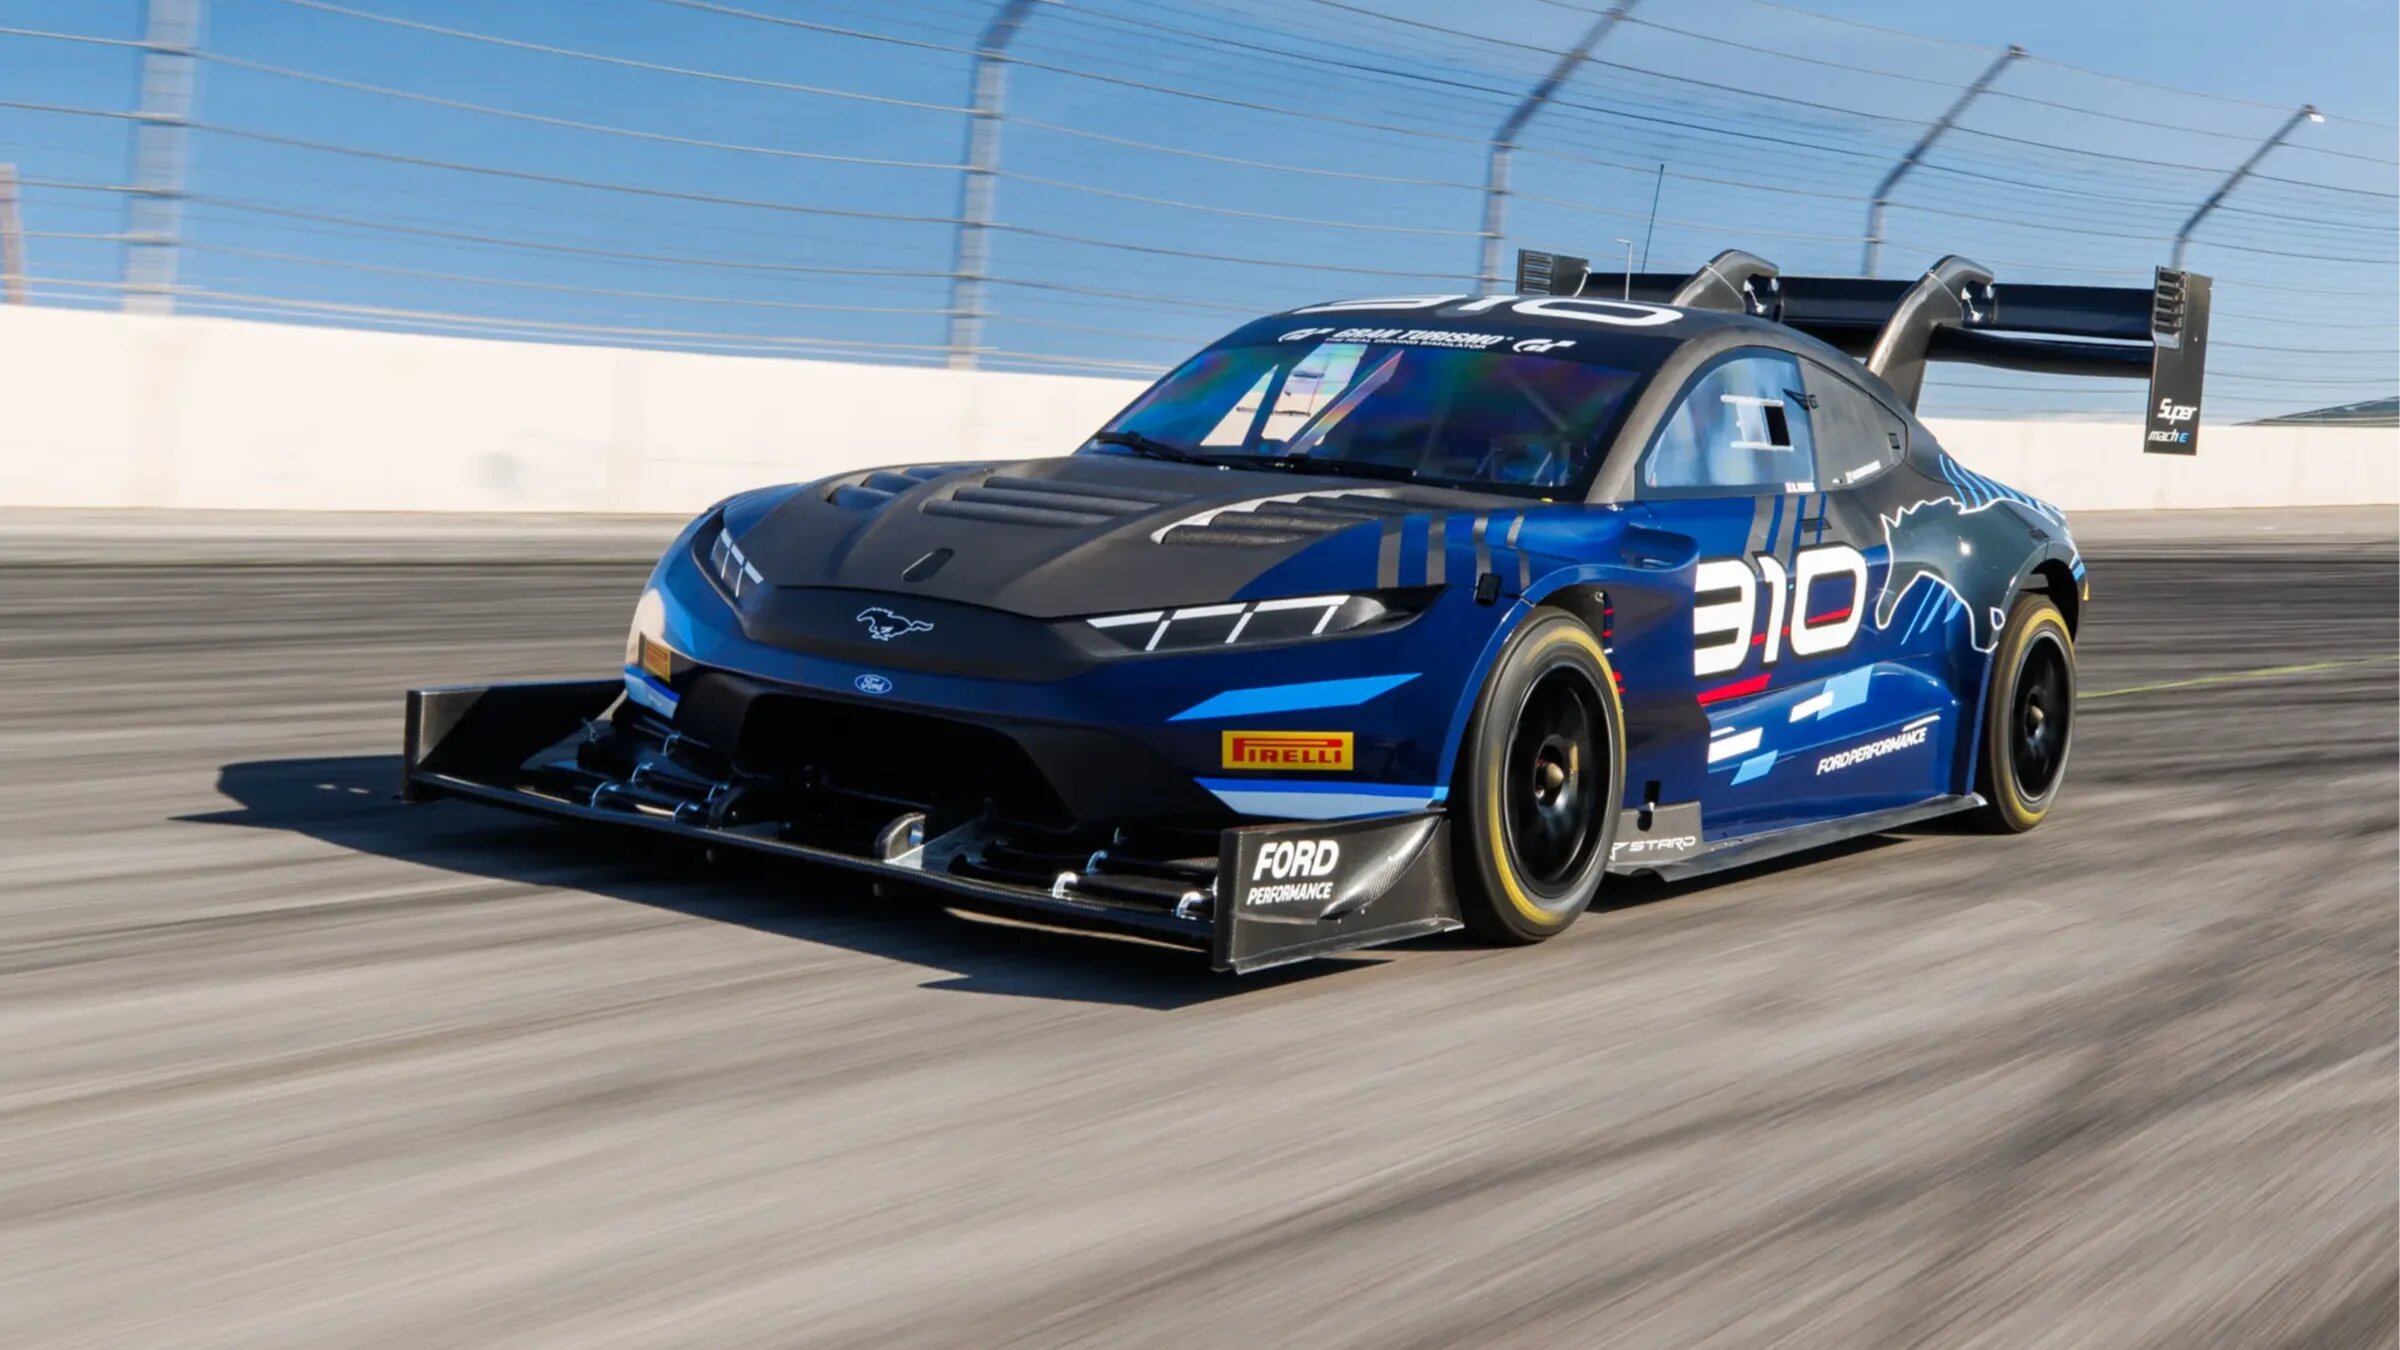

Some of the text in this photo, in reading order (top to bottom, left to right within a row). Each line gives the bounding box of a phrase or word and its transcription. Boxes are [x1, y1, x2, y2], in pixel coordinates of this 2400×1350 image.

[1332, 327, 1404, 339] GRAN
[1397, 329, 1505, 346] TURISMO
[2157, 398, 2198, 425] Super
[1693, 545, 1868, 676] 310
[1232, 737, 1344, 763] PIRELLI
[1816, 726, 1928, 776] FORD PERFORMANCE
[1252, 839, 1340, 881] FORD
[1246, 882, 1334, 906] PERFORMANCE
